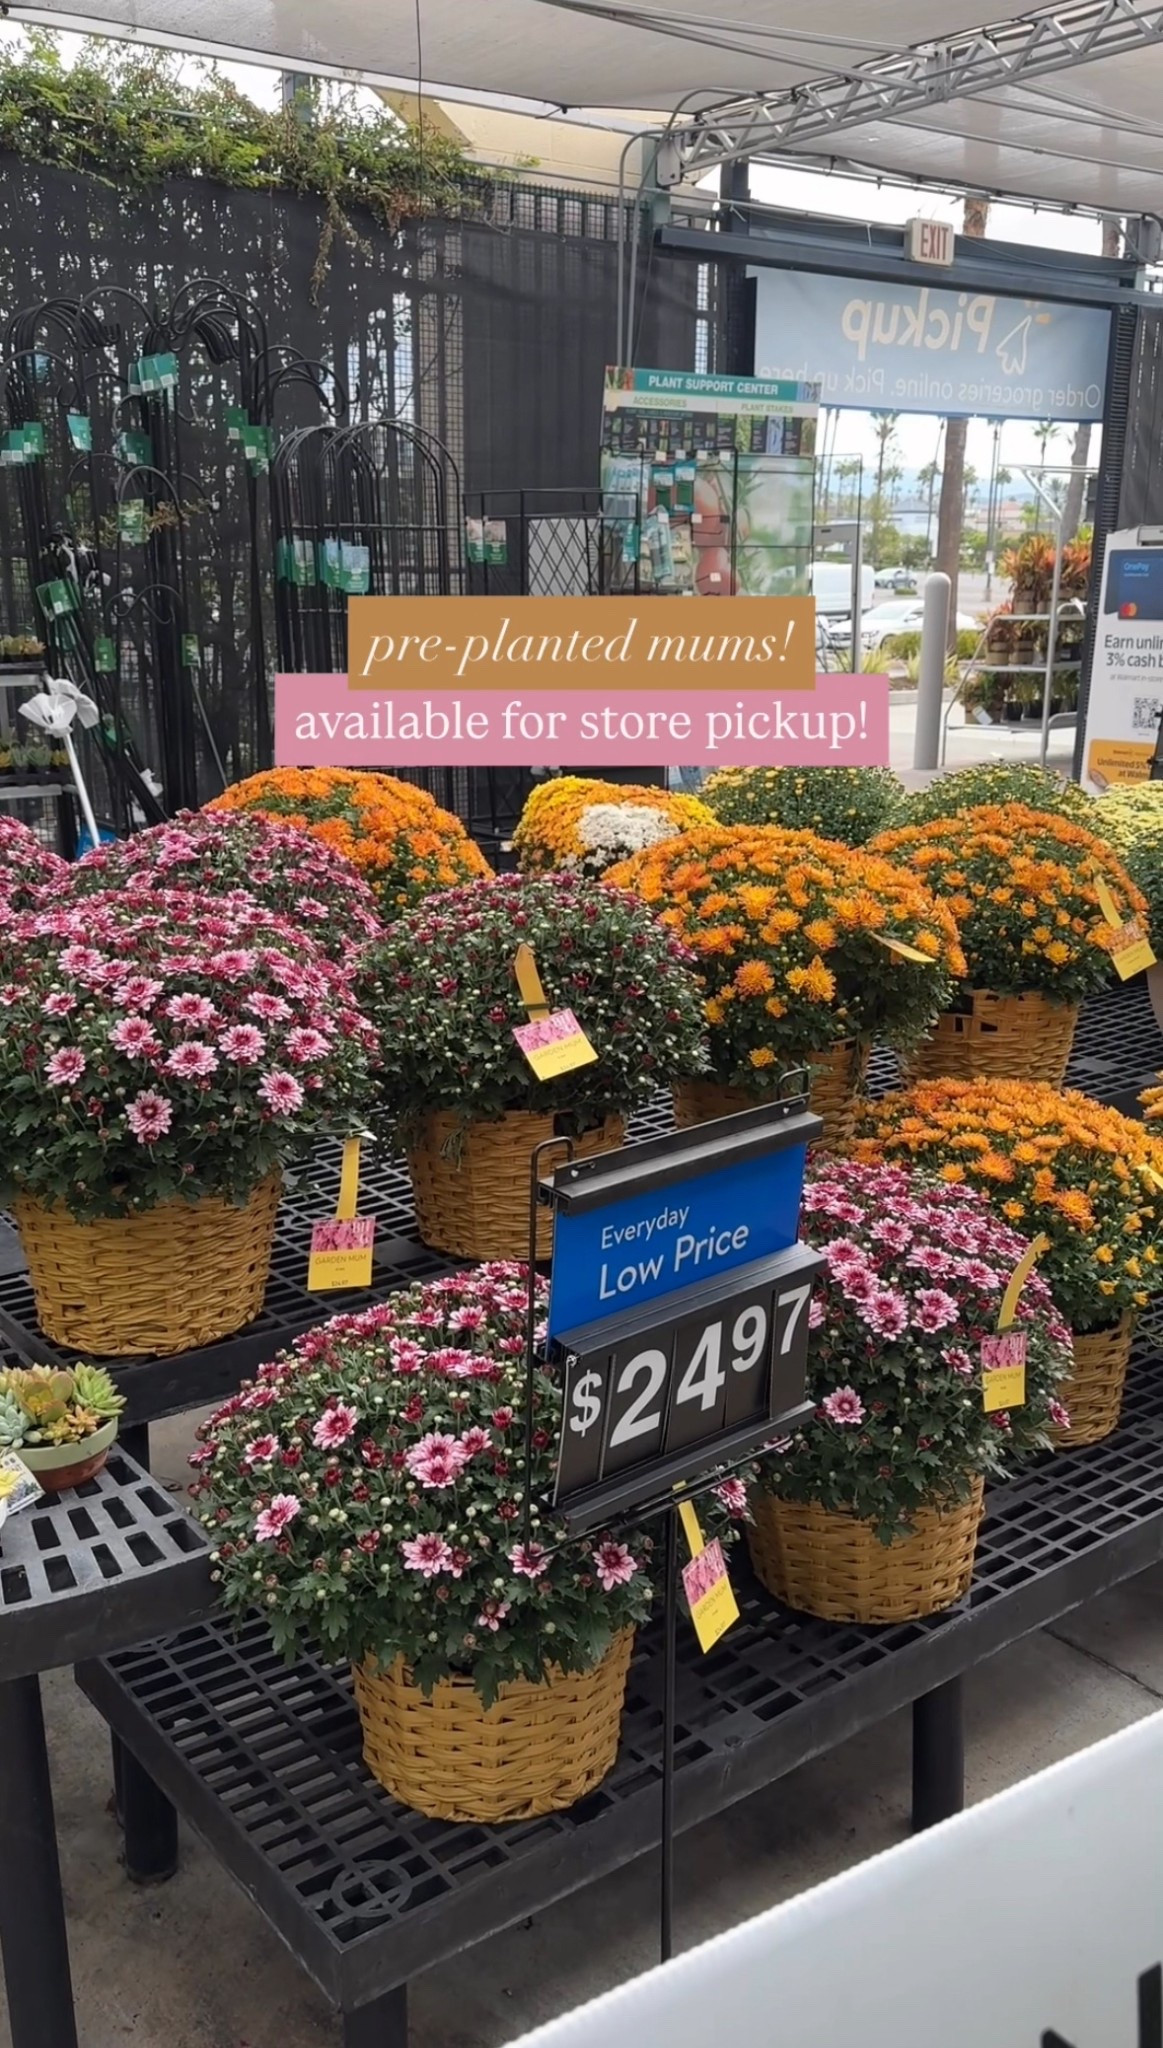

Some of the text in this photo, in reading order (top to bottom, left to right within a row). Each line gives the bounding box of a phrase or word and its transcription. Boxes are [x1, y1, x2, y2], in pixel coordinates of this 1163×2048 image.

[921, 223, 949, 261] EXIT
[649, 375, 779, 396] PLANT SUPPORT CENTER
[633, 396, 687, 408] ACCESSORIES
[741, 403, 765, 412] PLANT
[1104, 634, 1134, 649] Earn
[1106, 652, 1125, 667] 3%
[1127, 653, 1155, 668] cash
[601, 1206, 690, 1250] Everyday
[315, 1254, 367, 1265] GARDEN MUM
[599, 1223, 750, 1299] Low Price
